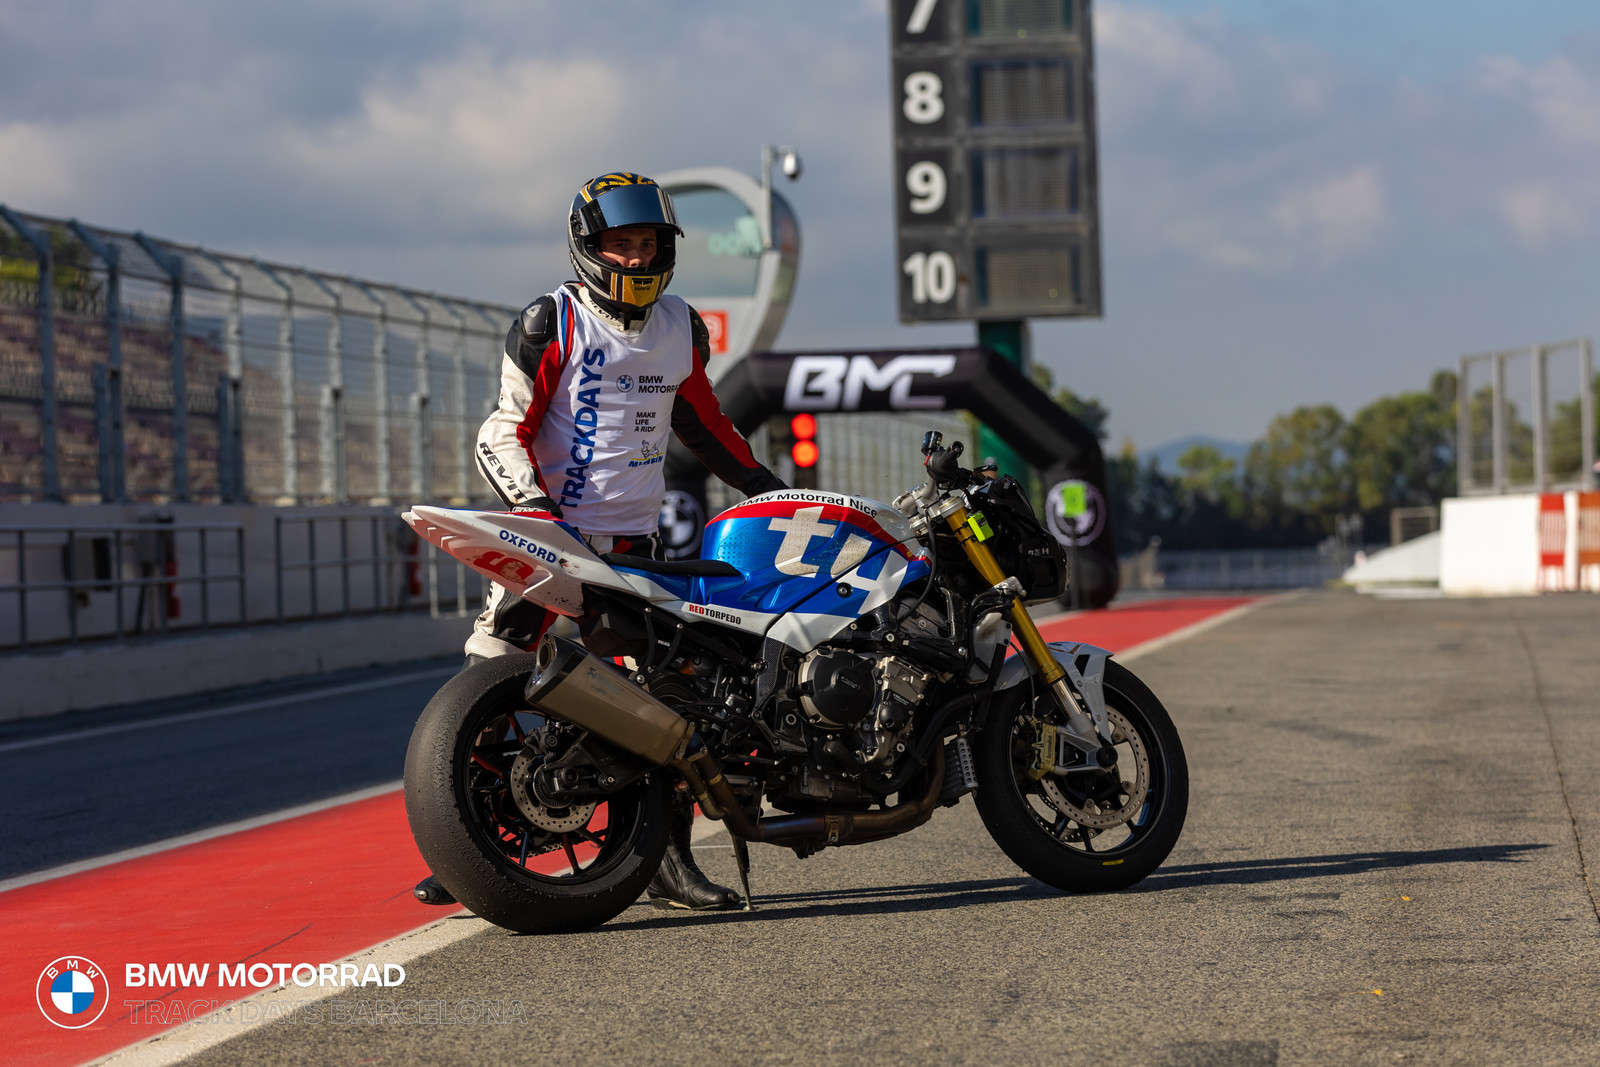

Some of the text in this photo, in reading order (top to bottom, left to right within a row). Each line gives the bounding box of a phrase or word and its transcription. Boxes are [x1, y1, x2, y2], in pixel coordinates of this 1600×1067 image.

[903, 71, 945, 125] 8
[905, 160, 947, 215] 9
[902, 250, 956, 304] 10
[638, 375, 664, 384] BMW
[784, 355, 957, 410] BMC
[559, 348, 605, 508] TRACKDAYS
[777, 493, 844, 506] Motorrad
[849, 498, 878, 518] Nice
[499, 529, 557, 564] OXFORD
